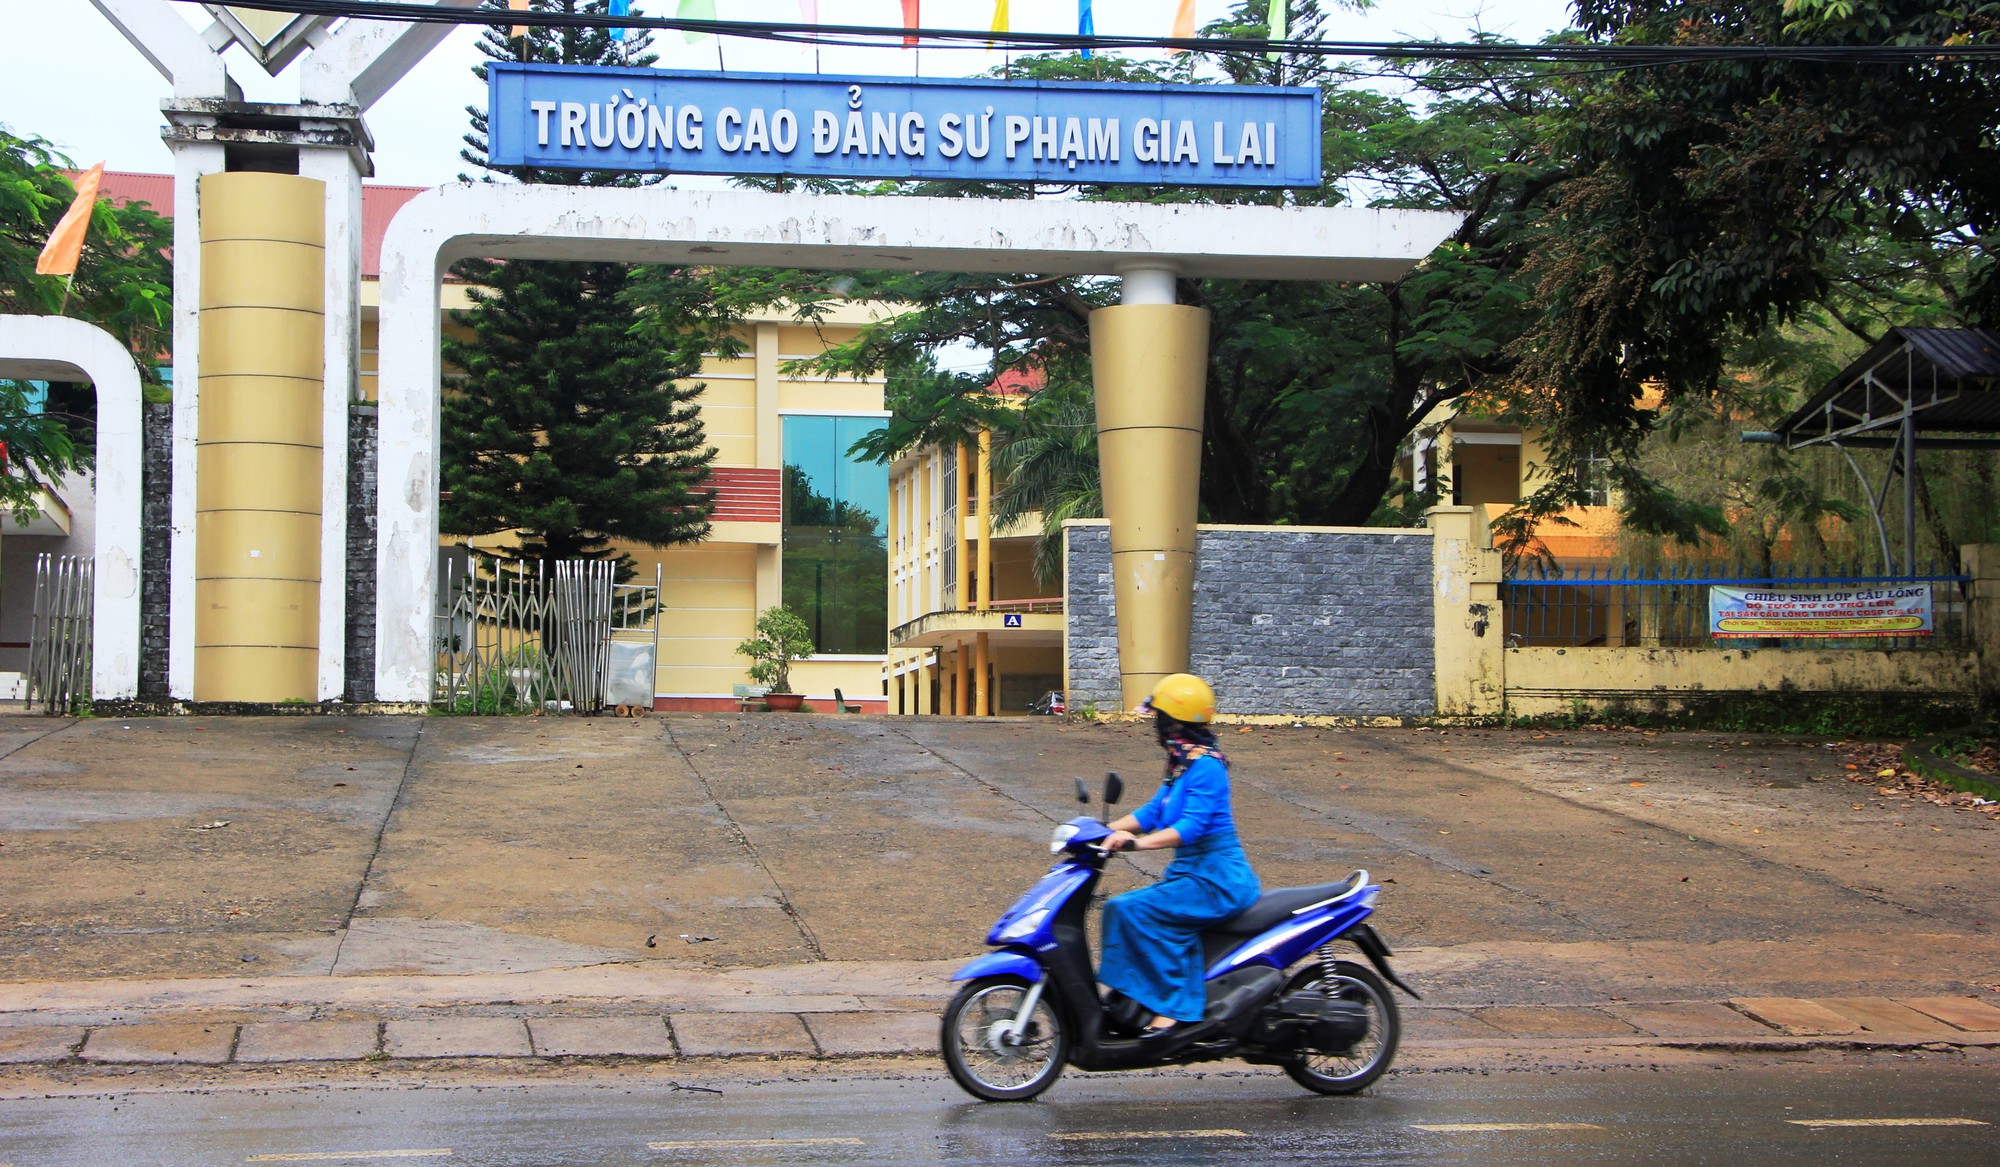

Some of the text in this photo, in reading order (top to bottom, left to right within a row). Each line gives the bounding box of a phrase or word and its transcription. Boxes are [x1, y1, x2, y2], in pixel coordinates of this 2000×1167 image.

[531, 88, 703, 150] TRƯỜNG
[716, 106, 798, 154] CAO
[938, 106, 994, 158] SƯ
[1005, 115, 1120, 169] PHẠM
[1133, 117, 1199, 164] GIA
[1213, 121, 1275, 165] LAI
[1790, 594, 1822, 602] SINH
[1887, 587, 1924, 598] LÔNG
[1007, 615, 1019, 626] A
